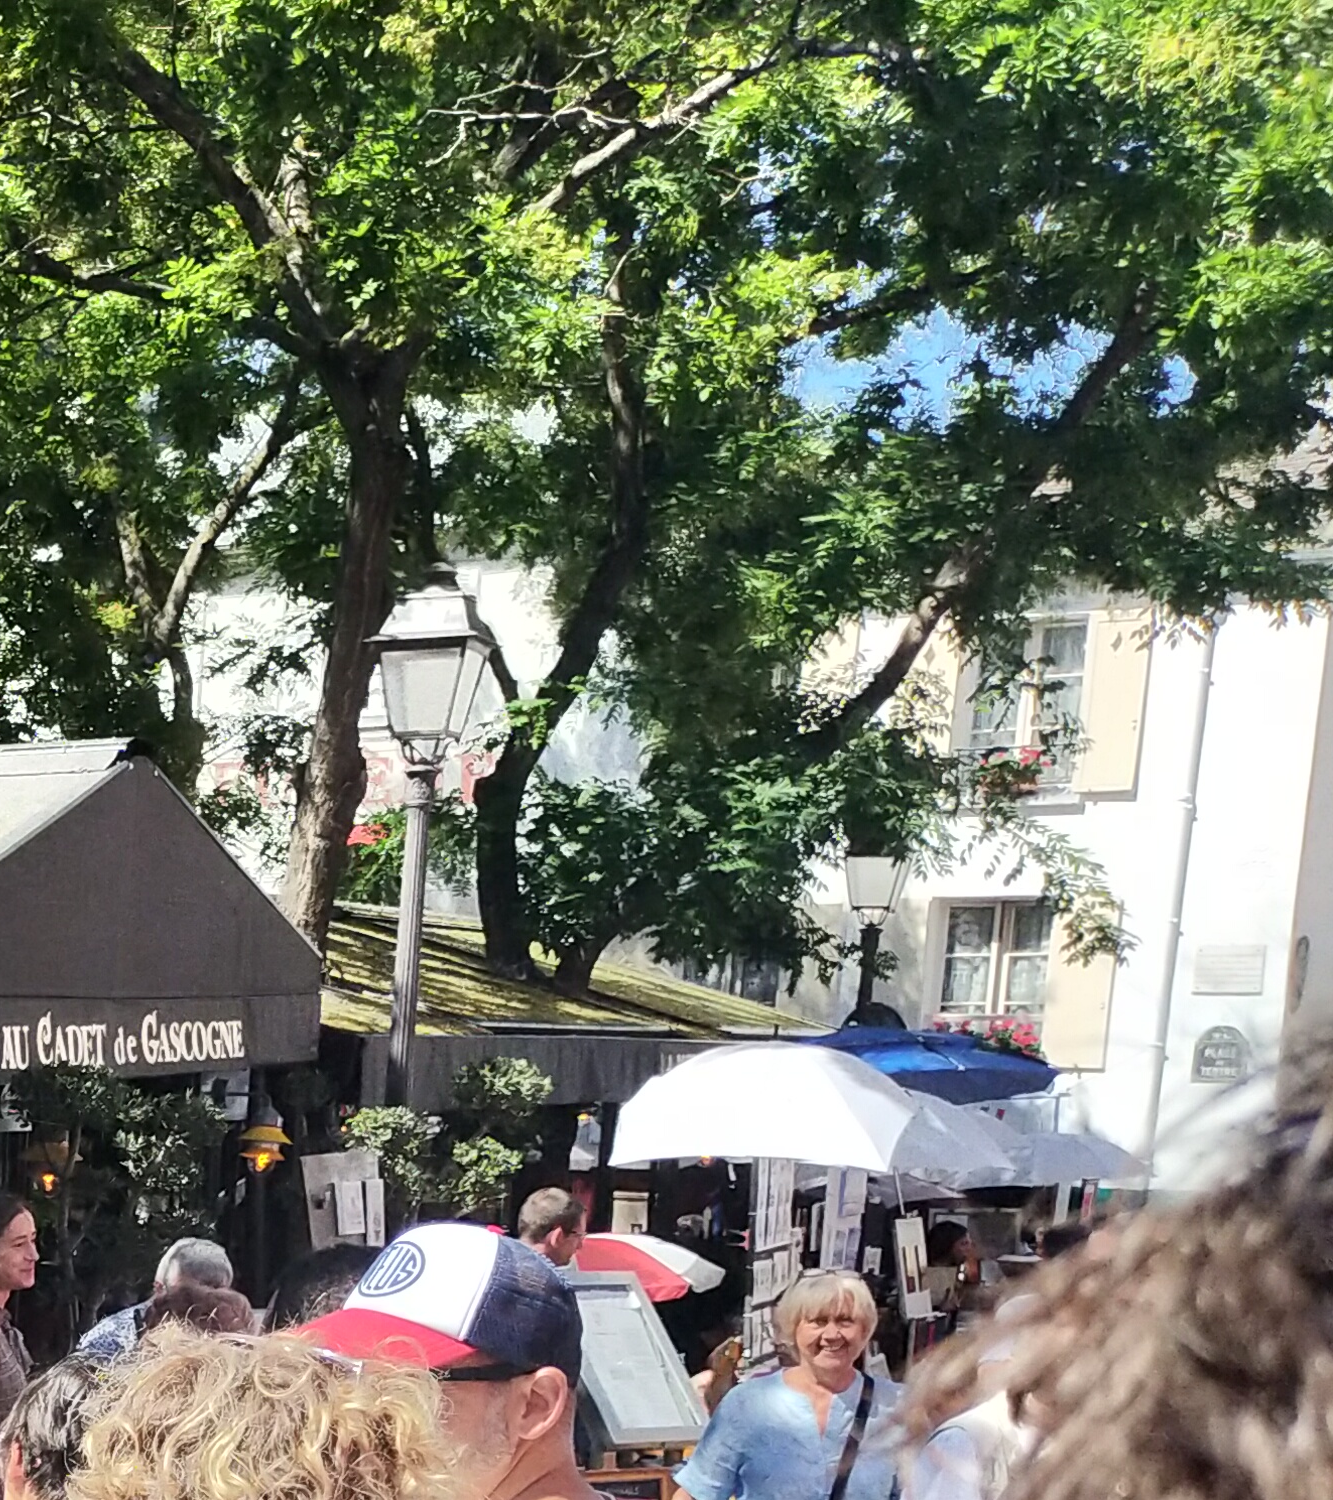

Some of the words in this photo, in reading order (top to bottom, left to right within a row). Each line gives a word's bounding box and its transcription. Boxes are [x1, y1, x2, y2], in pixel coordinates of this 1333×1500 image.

[1, 1025, 30, 1070] AU
[37, 1010, 108, 1068] CADET
[114, 1025, 138, 1066] de
[141, 1010, 245, 1065] GASCOGNE
